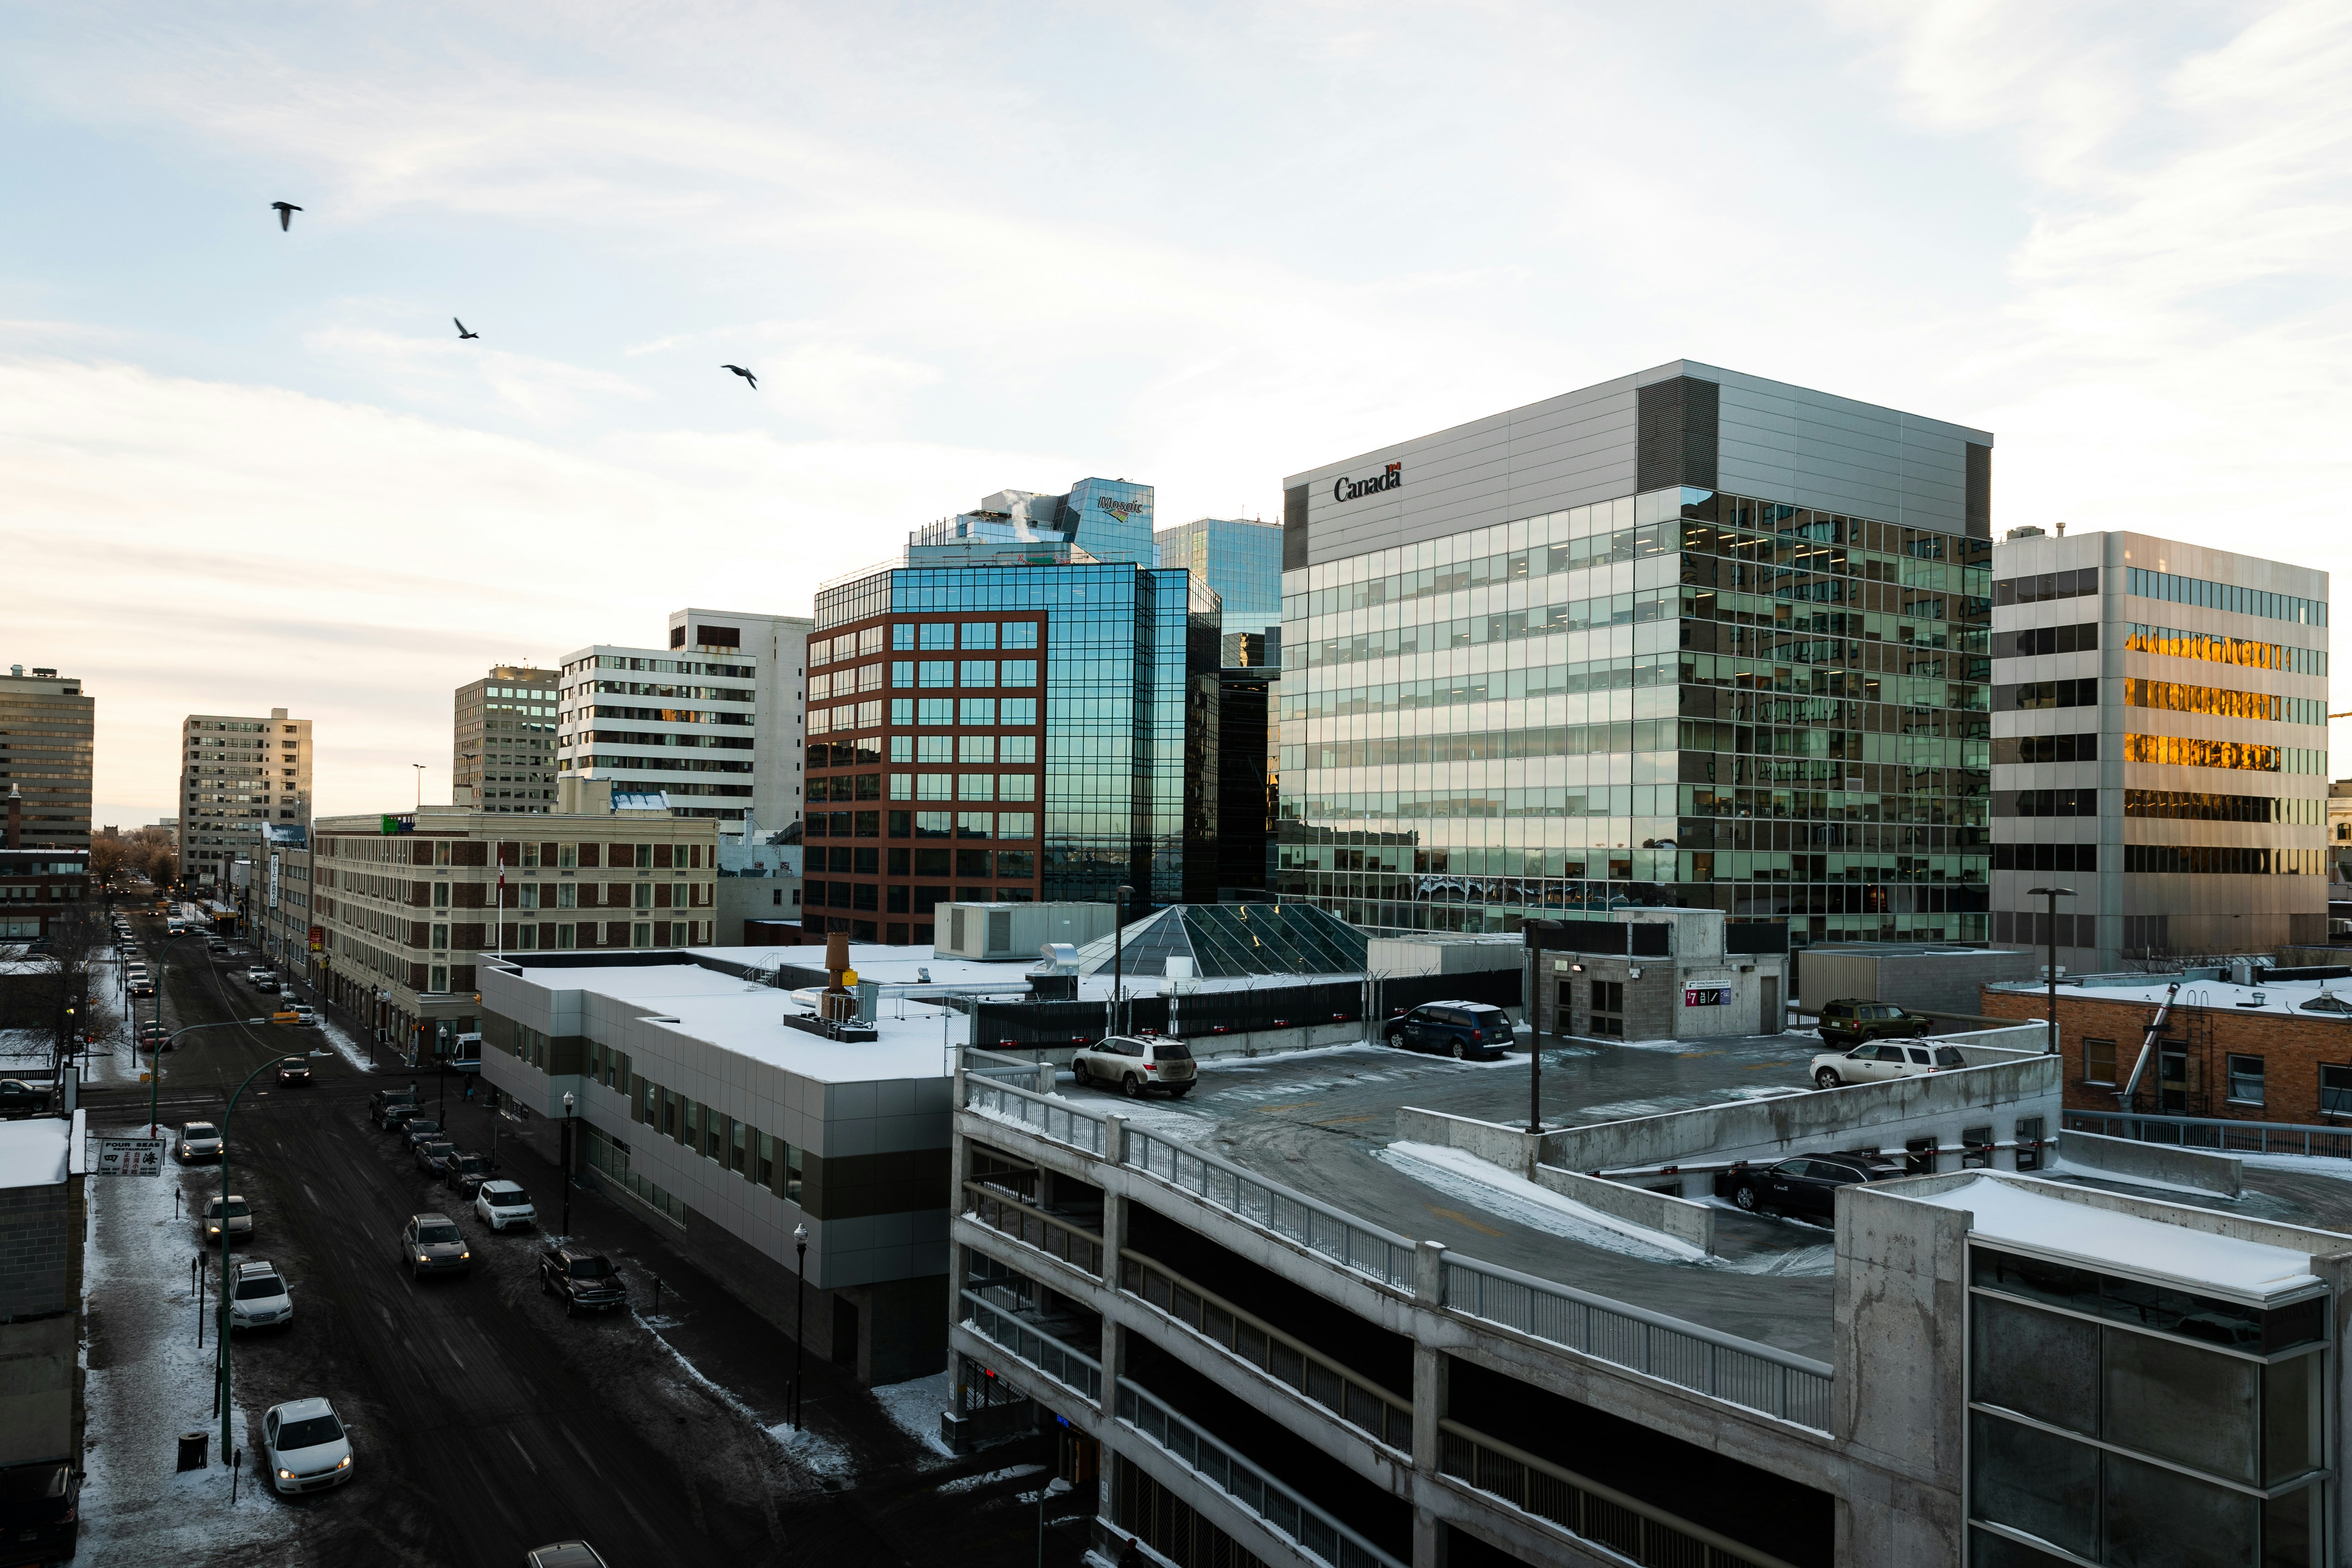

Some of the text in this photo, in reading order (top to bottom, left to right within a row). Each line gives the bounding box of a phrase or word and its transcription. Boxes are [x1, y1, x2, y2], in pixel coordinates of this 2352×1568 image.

[1334, 464, 1402, 502] Canada
[1099, 496, 1143, 513] Mosaic
[1687, 992, 1696, 1004] L7
[104, 1152, 158, 1165] 四 海
[121, 1152, 131, 1175] 正宗川菜
